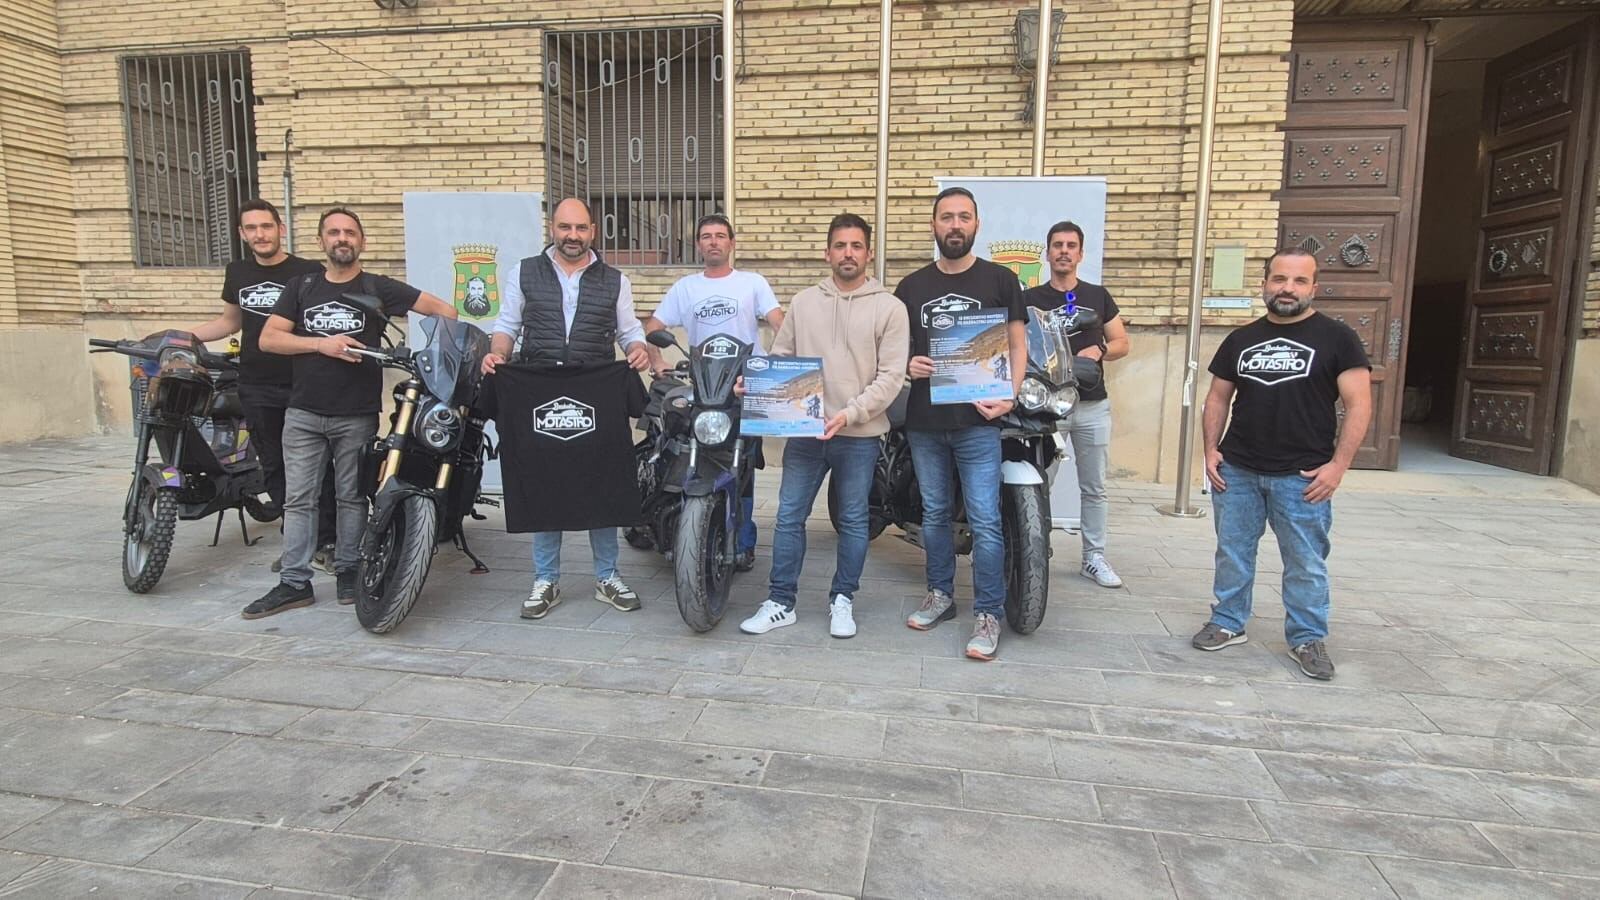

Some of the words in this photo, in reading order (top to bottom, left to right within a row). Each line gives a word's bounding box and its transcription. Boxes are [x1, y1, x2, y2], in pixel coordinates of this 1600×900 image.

[241, 296, 276, 306] MOTAS
[695, 307, 736, 319] MOTASTRO
[306, 318, 362, 330] MOTASTRO
[1240, 358, 1306, 372] MOTASTRO
[536, 416, 593, 428] MOTASTRO
